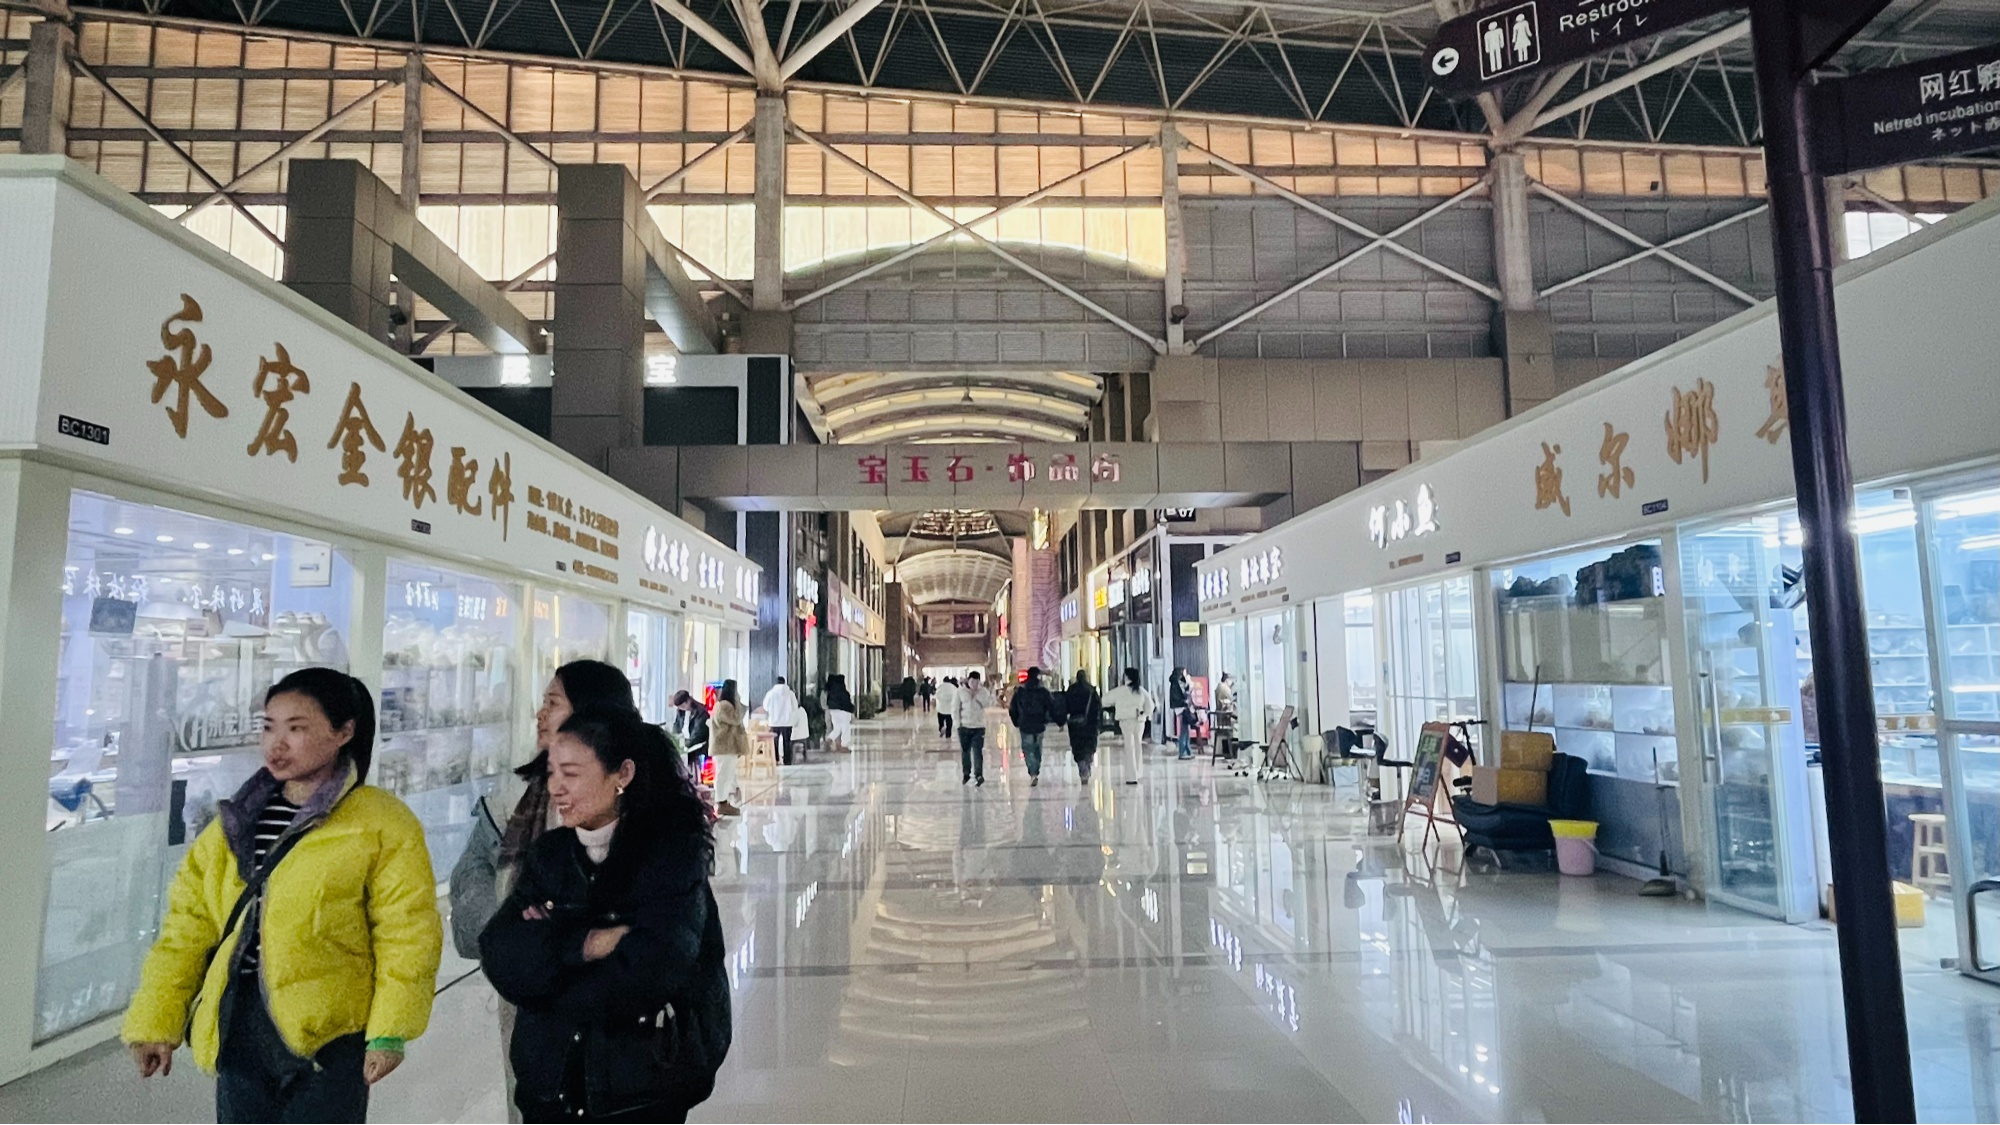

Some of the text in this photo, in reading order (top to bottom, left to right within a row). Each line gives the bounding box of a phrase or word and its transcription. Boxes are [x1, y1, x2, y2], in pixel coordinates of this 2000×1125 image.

[1590, 14, 1648, 43] トイレ
[1873, 113, 1922, 134] Netred
[61, 417, 107, 443] BC1301
[146, 293, 515, 541] 永宏金银配件
